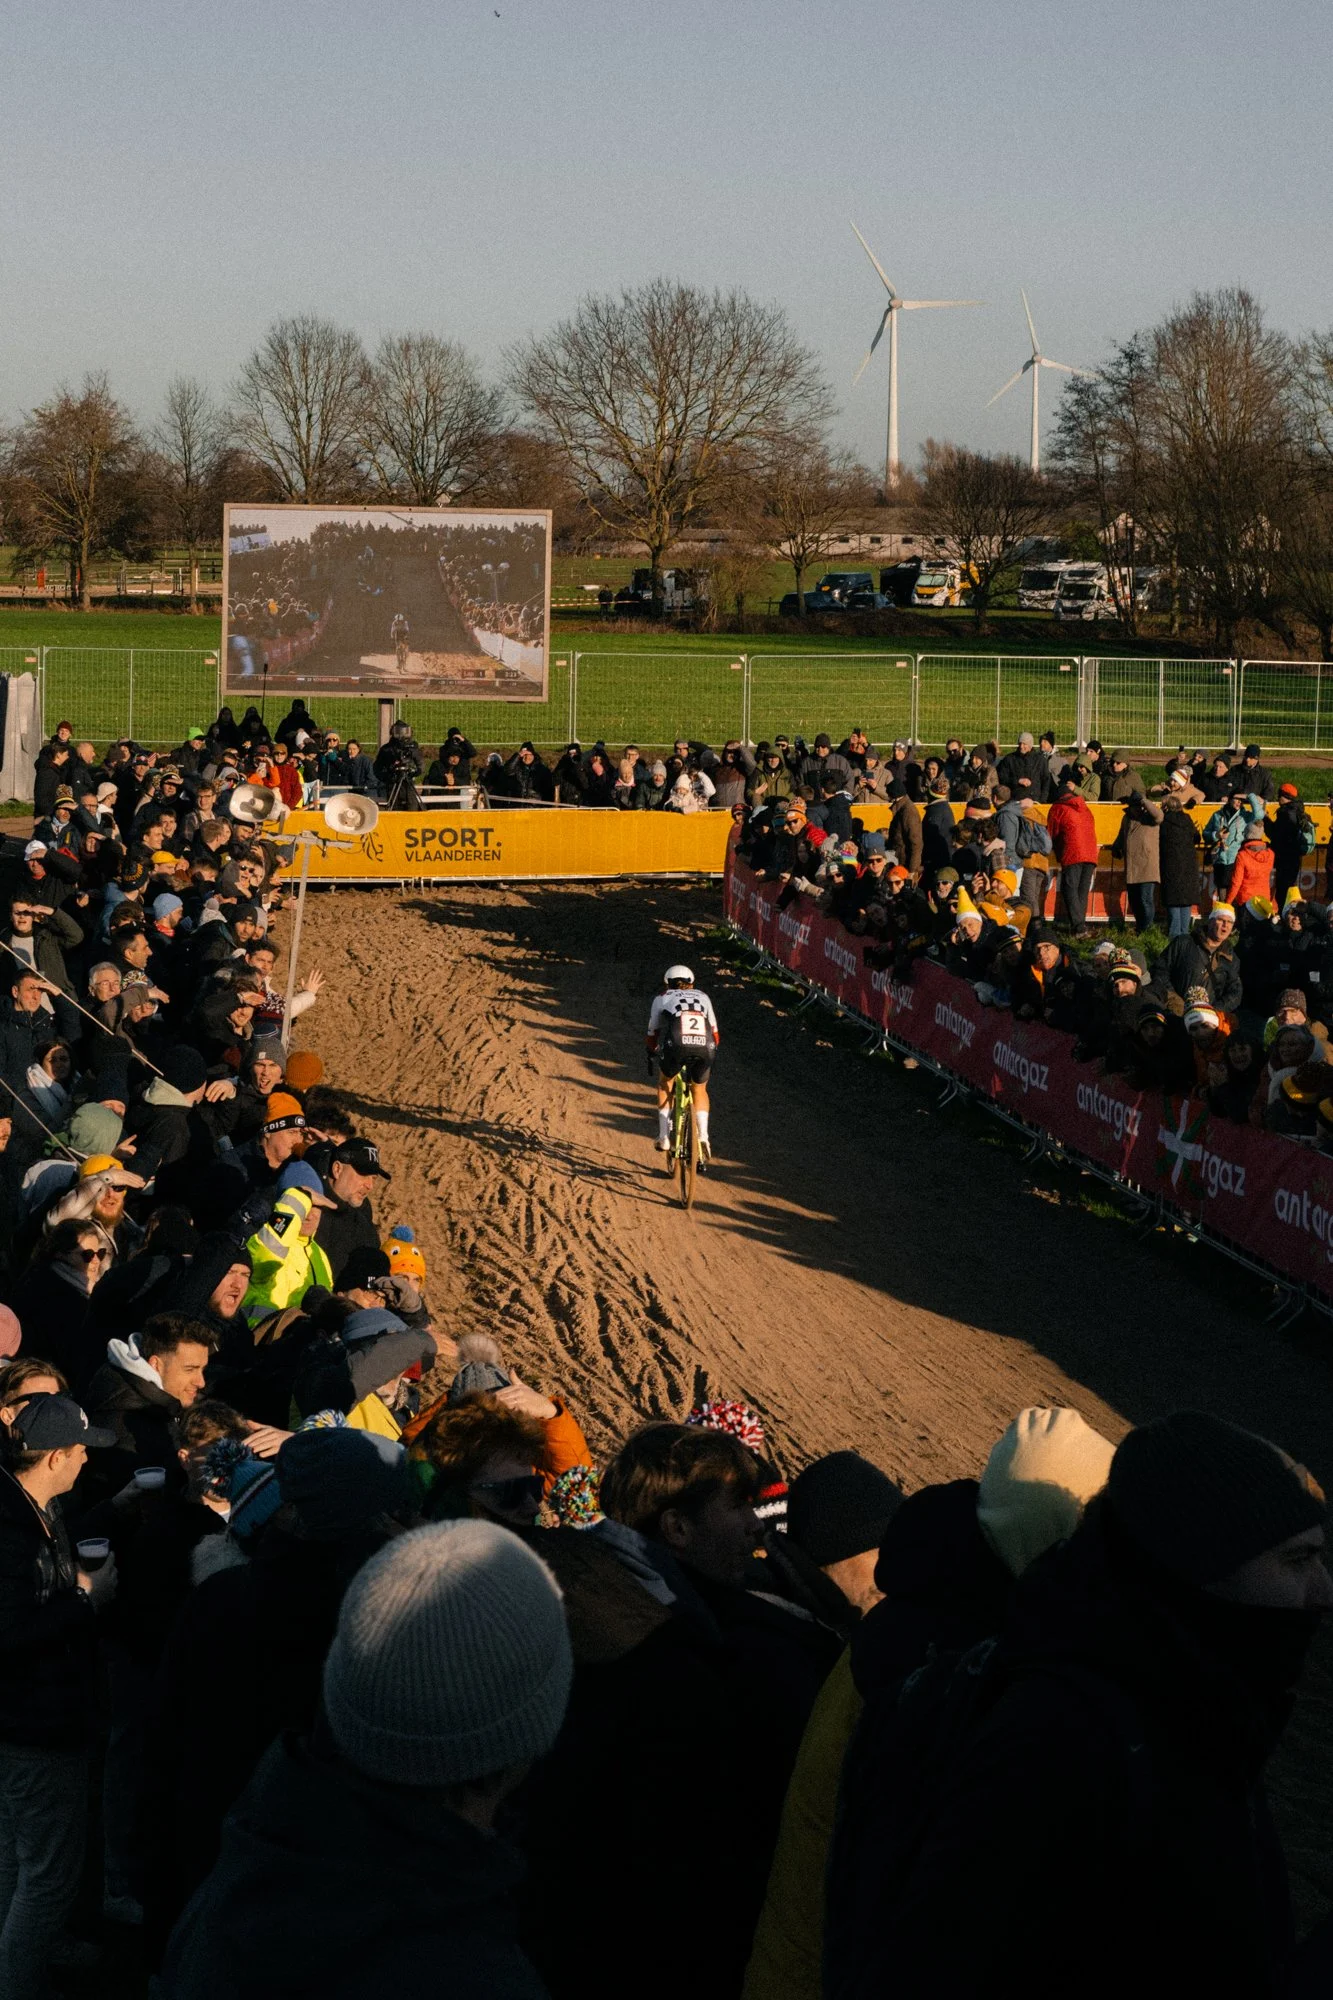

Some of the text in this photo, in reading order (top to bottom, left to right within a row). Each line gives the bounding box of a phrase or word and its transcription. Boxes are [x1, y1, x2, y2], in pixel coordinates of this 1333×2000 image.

[404, 828, 502, 848] SPORT.
[405, 850, 501, 862] VLAANDEREN
[688, 1017, 700, 1031] 2
[935, 1002, 976, 1052] antargaz
[993, 1040, 1049, 1094] antargaz
[1077, 1081, 1143, 1141] antargaz
[1201, 1150, 1246, 1199] rgaz
